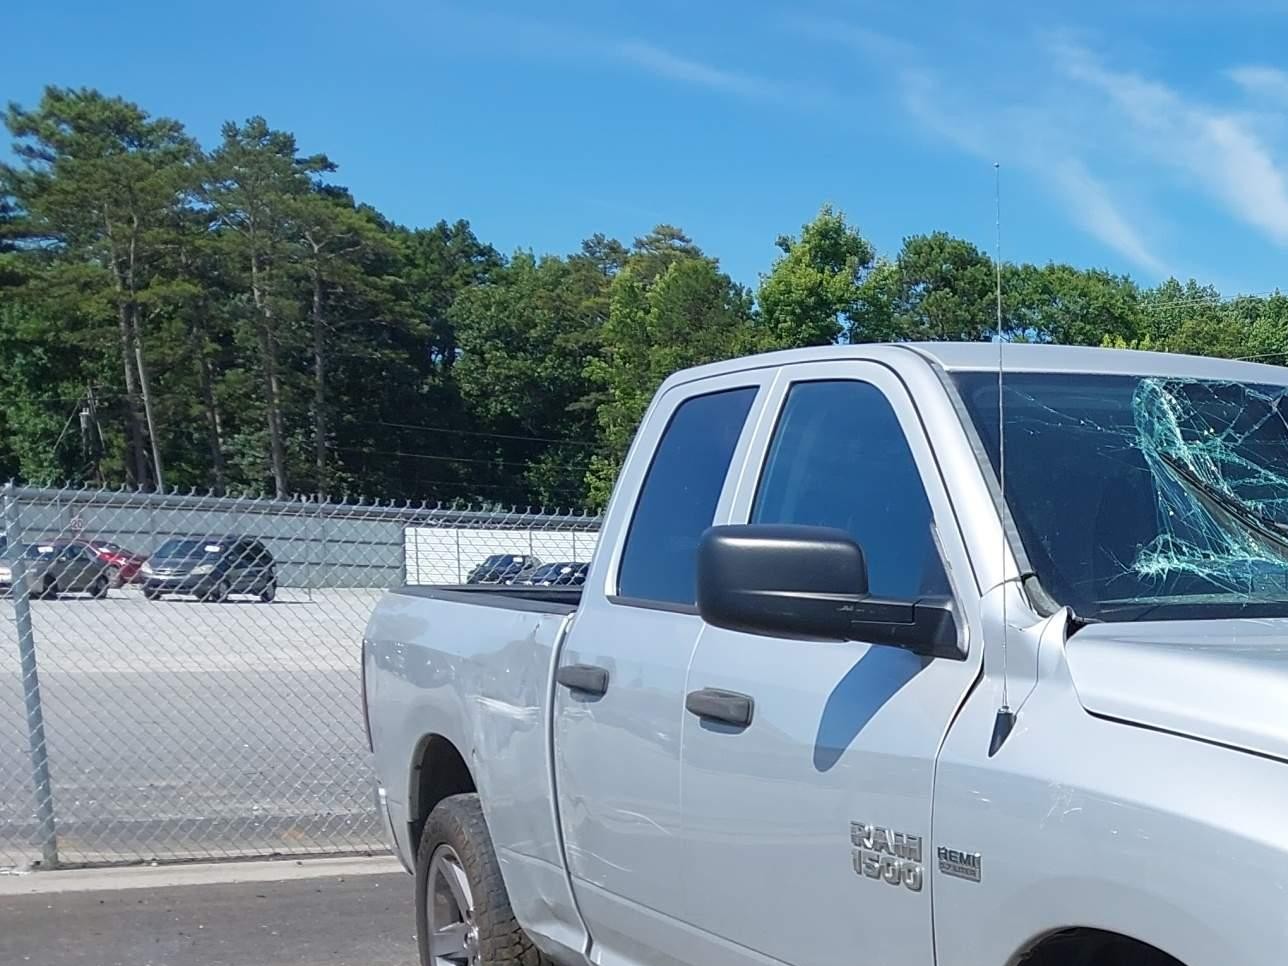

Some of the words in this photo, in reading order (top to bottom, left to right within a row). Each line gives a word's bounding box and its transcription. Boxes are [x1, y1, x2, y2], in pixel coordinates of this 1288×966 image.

[851, 821, 922, 862] RAM
[937, 846, 977, 867] HEMI
[852, 849, 923, 892] 1500
